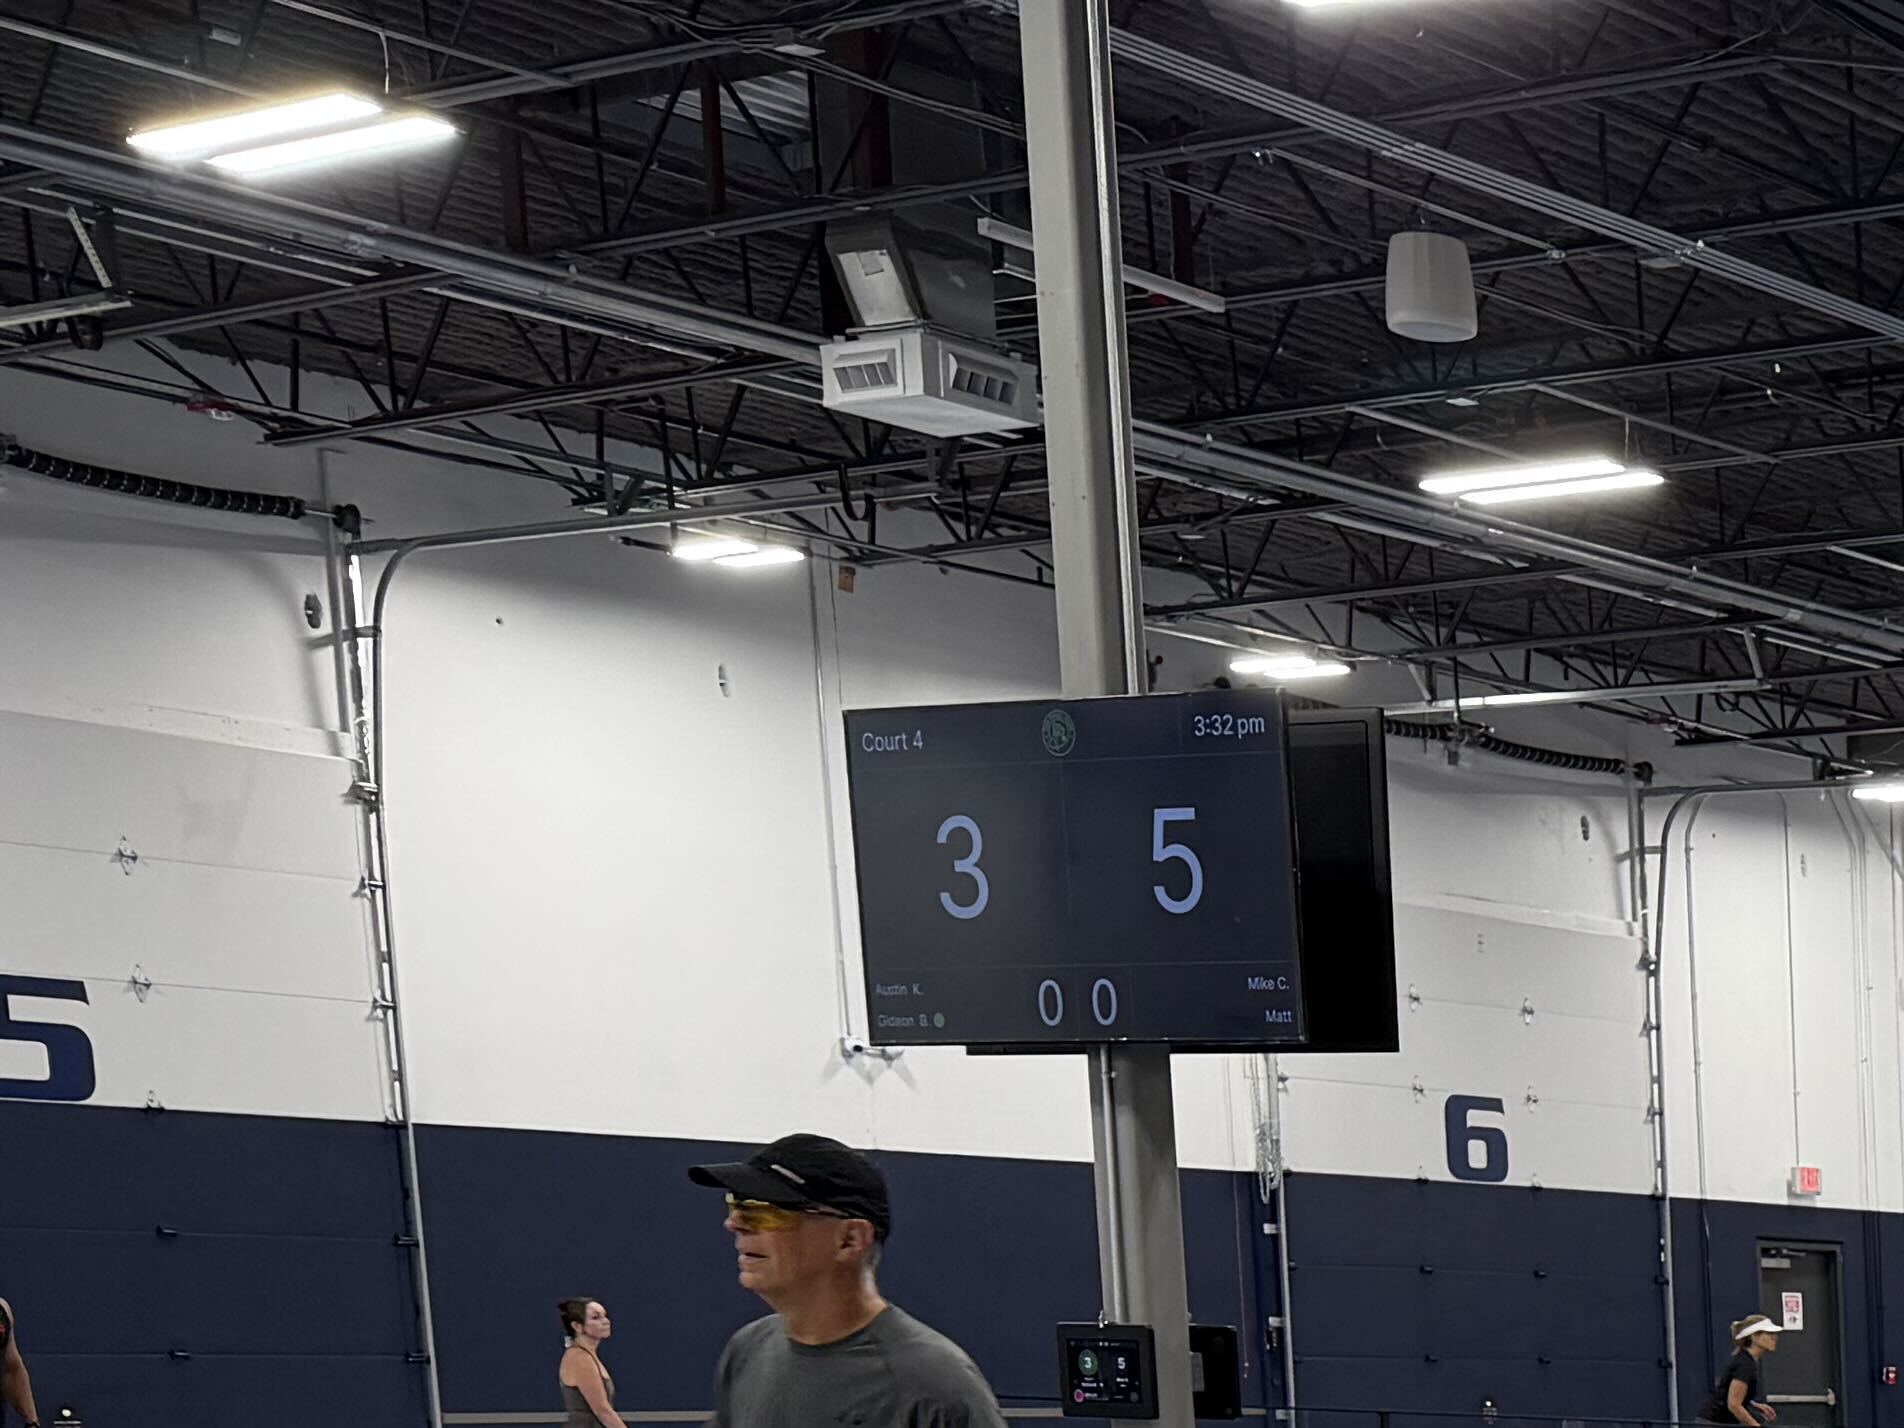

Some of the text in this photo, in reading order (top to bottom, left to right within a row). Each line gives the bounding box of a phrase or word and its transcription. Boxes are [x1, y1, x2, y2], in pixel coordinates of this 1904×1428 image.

[861, 730, 924, 753] Court 4
[1193, 715, 1265, 739] 3:32 pm
[935, 814, 989, 920] 3
[1152, 807, 1204, 914] 5
[1247, 976, 1291, 990] Mike C.
[1038, 978, 1118, 1027] 0 0
[1265, 1009, 1293, 1023] Matt
[1444, 1094, 1509, 1183] 6
